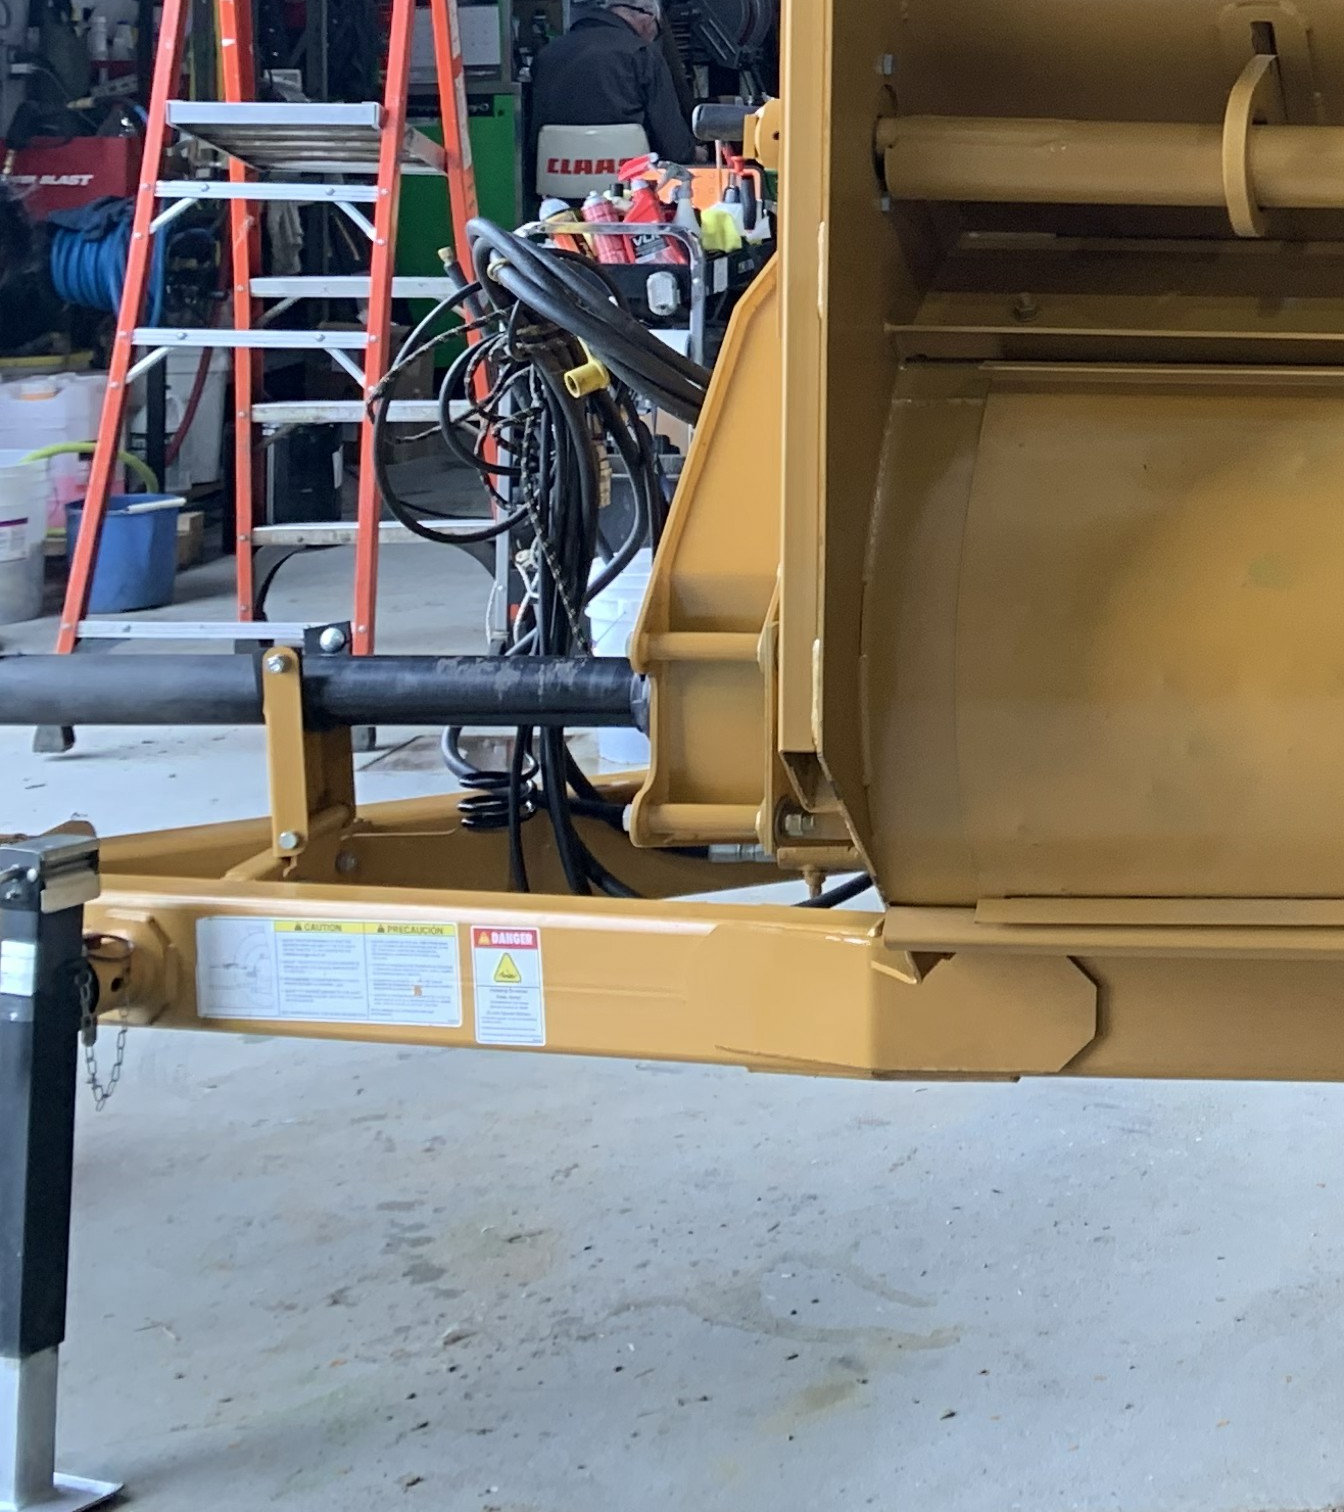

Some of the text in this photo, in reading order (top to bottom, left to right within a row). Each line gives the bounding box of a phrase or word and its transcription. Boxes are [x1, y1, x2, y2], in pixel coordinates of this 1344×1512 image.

[304, 923, 342, 932] CAUTION
[387, 924, 443, 935] PRECAUCIÓN
[490, 931, 533, 946] DANGER
